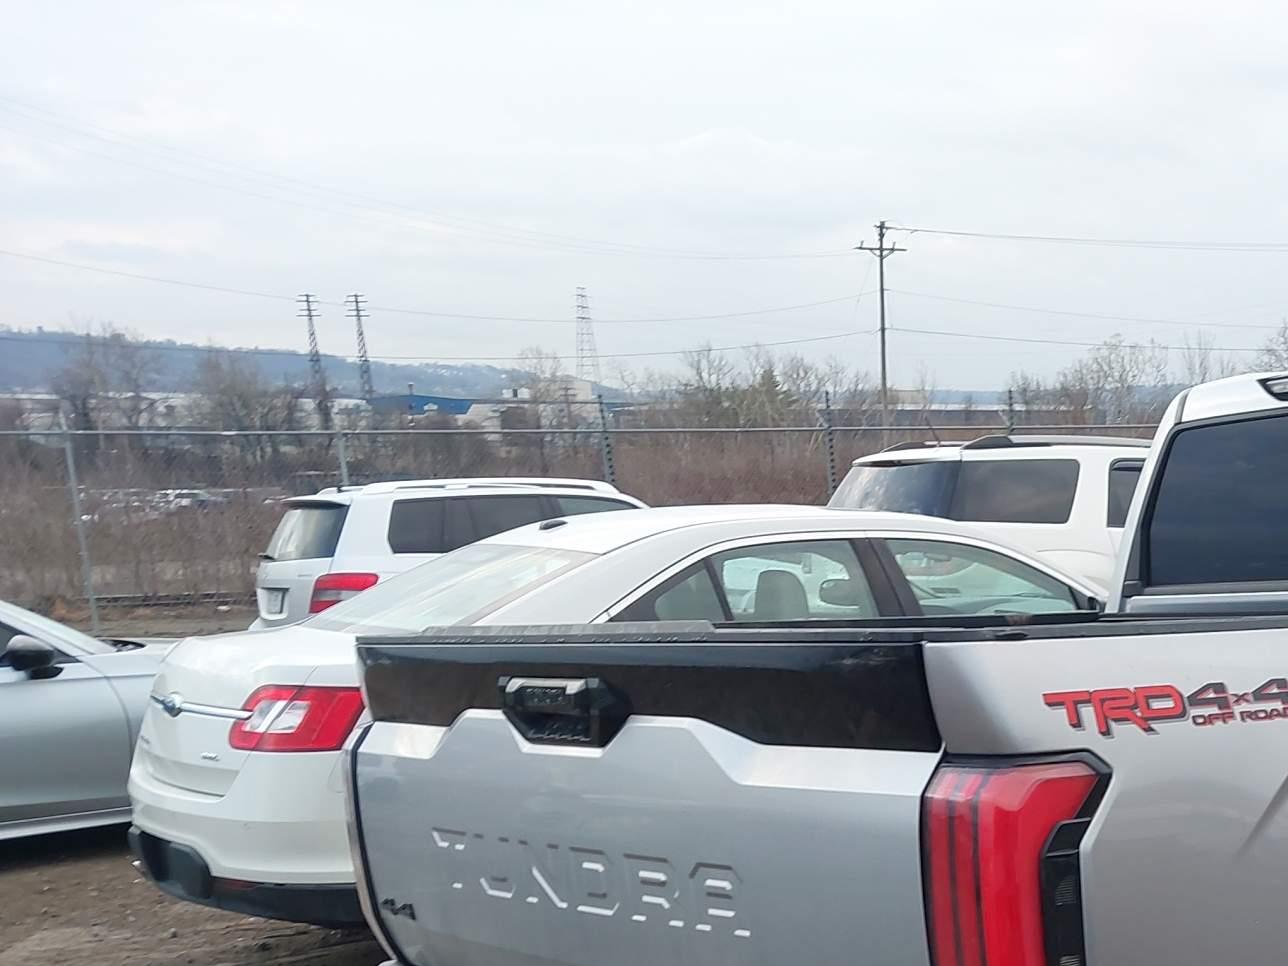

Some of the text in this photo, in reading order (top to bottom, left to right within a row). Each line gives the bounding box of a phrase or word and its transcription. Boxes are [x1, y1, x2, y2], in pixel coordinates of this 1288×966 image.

[1042, 684, 1189, 738] TRD
[1191, 711, 1234, 726] OFF
[431, 826, 752, 937] TUNDRA
